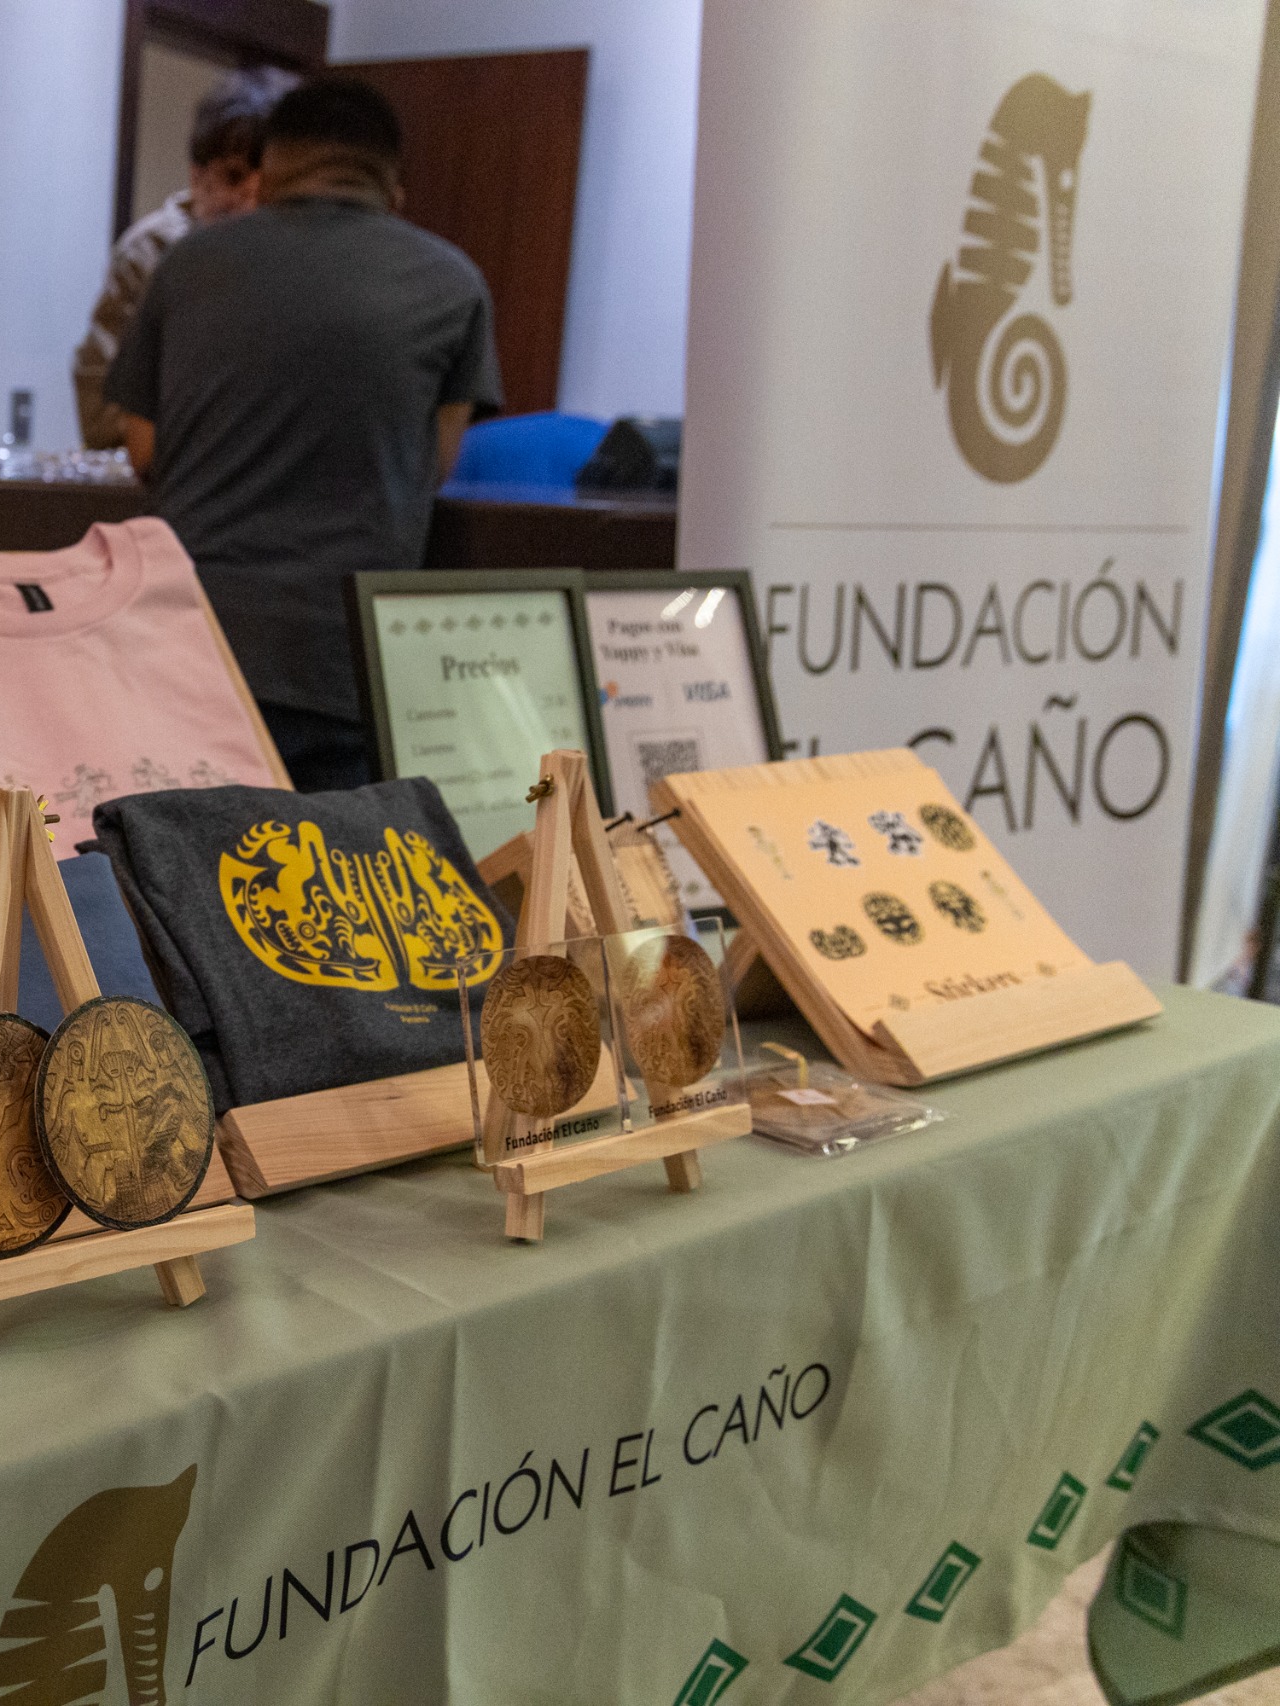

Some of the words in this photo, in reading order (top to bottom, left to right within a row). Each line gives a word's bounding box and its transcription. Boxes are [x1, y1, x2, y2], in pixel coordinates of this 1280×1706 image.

[766, 556, 1185, 676] FUNDACIÓN
[440, 652, 520, 681] Precios
[905, 692, 1170, 834] AÑO
[923, 970, 1023, 1002] Stickers
[648, 1097, 694, 1119] Fundación
[694, 1094, 704, 1108] El
[705, 1089, 728, 1105] Caño
[505, 1124, 560, 1151] Fundación
[561, 1122, 572, 1139] El
[572, 1117, 600, 1135] Caño
[185, 1446, 591, 1688] FUNDACIÓN
[608, 1427, 663, 1498] EL
[682, 1362, 832, 1466] CAÑO
